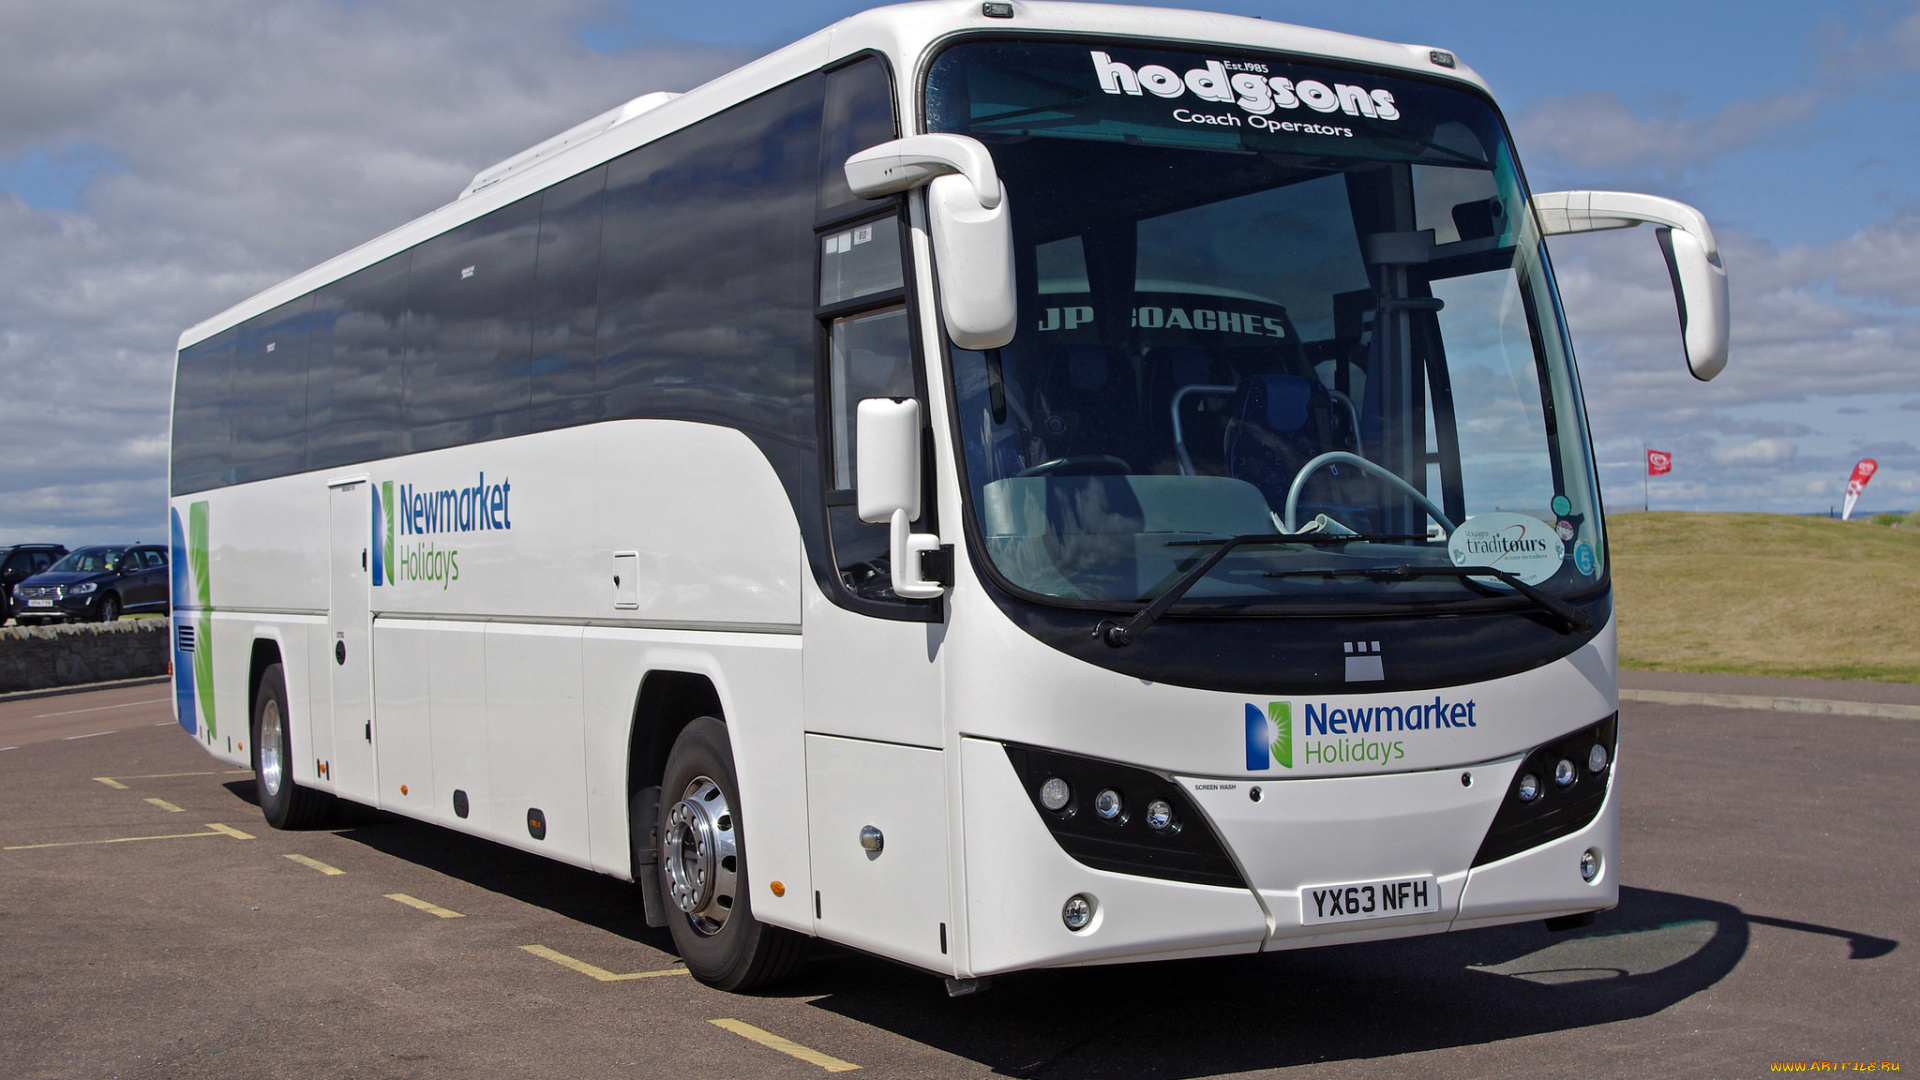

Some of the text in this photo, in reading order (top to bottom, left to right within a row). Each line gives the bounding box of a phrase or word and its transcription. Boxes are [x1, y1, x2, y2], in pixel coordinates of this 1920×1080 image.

[1090, 51, 1400, 121] hodgsons
[1173, 108, 1353, 138] Coach Operators
[1038, 306, 1286, 338] JP OACHES
[400, 471, 511, 535] Newmarket
[1466, 533, 1547, 554] traditours
[1581, 551, 1591, 571] 5
[400, 541, 459, 591] Holidays
[1305, 696, 1477, 735] Newmarket
[1305, 738, 1405, 765] Holidays
[1312, 880, 1428, 918] YX63 NFH
